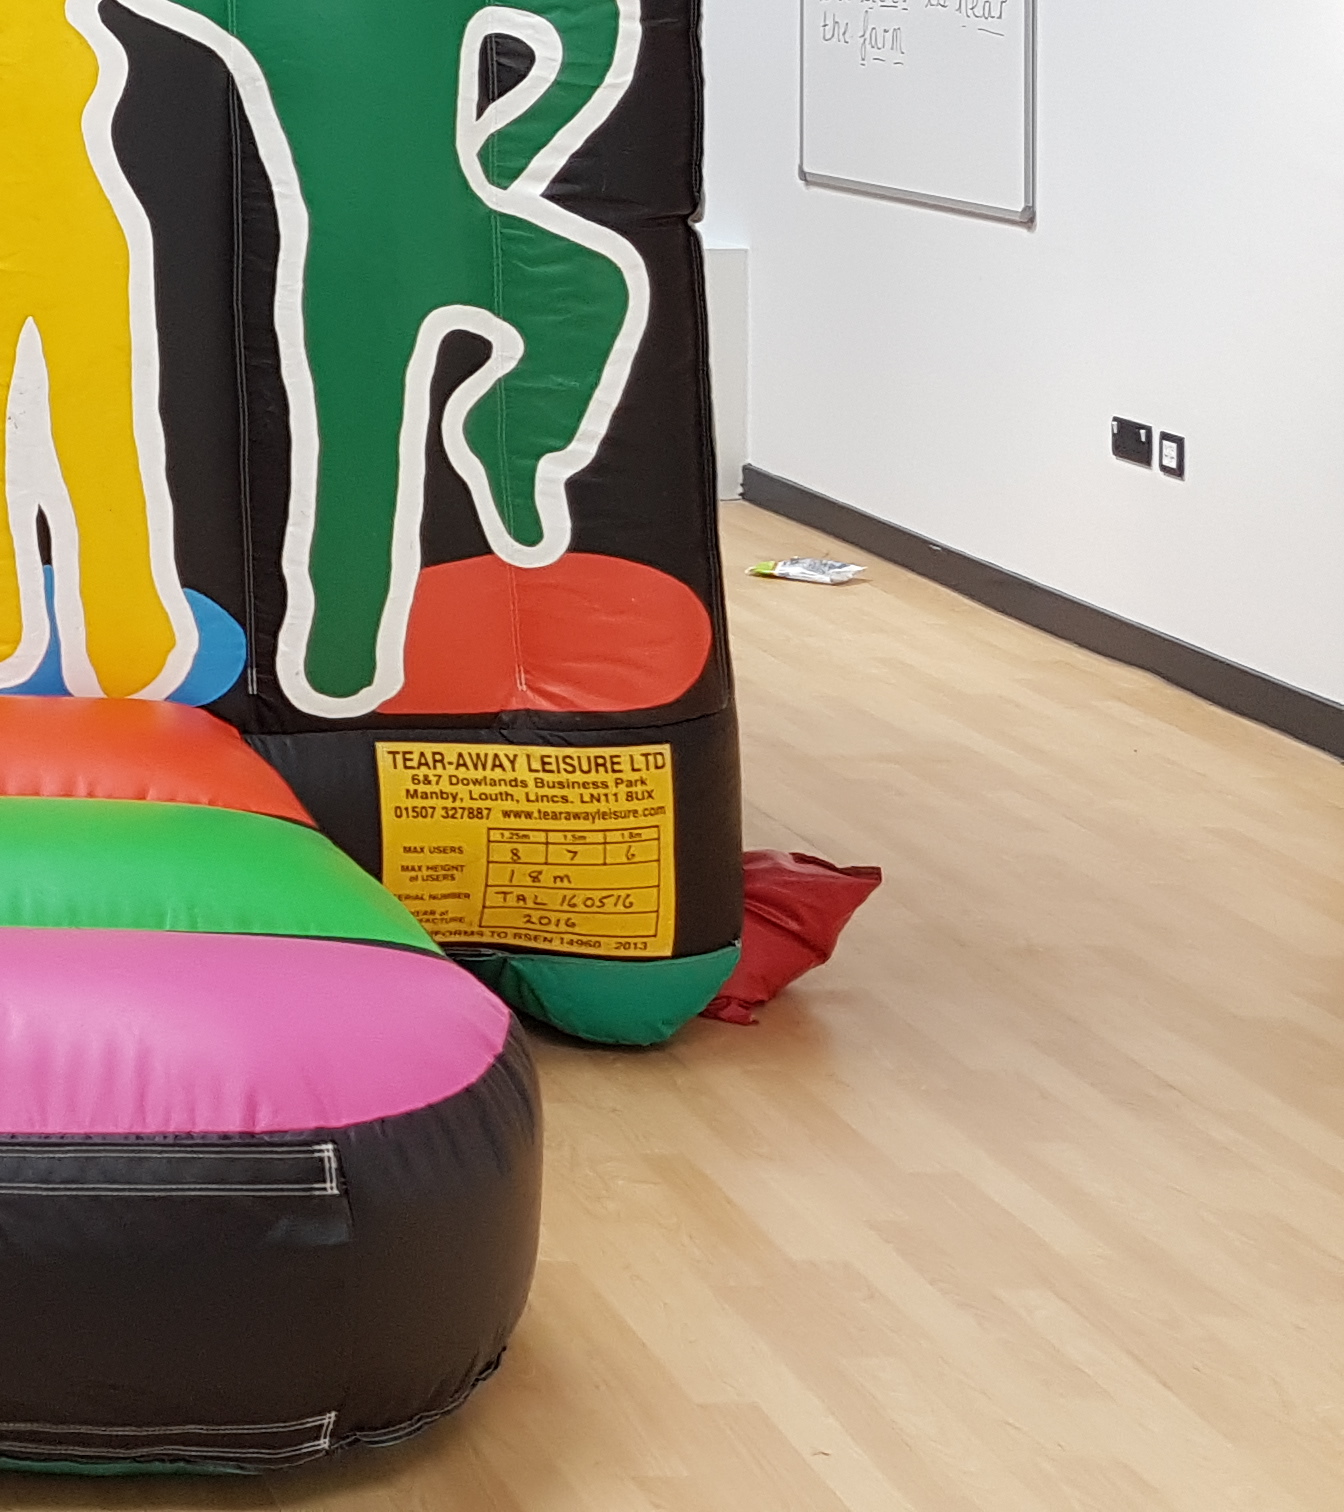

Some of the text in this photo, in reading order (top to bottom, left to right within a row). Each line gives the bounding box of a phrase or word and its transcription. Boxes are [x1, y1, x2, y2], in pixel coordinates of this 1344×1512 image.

[821, 11, 849, 44] the
[387, 750, 666, 774] TEAR-AWAY LEISURE LTD
[411, 773, 648, 789] 6&7 Dowlands Business Park
[405, 788, 655, 804] Manby, Louth, Lincs. LN11 8UX
[394, 805, 666, 824] 01507 327887 www.tearawayleisure.com
[402, 844, 636, 862] MAX USERS 8 7 6
[394, 893, 425, 901] ERIAL
[494, 891, 548, 906] TAL
[523, 914, 577, 928] 2016
[489, 930, 508, 939] TO
[614, 941, 647, 950] 2013
